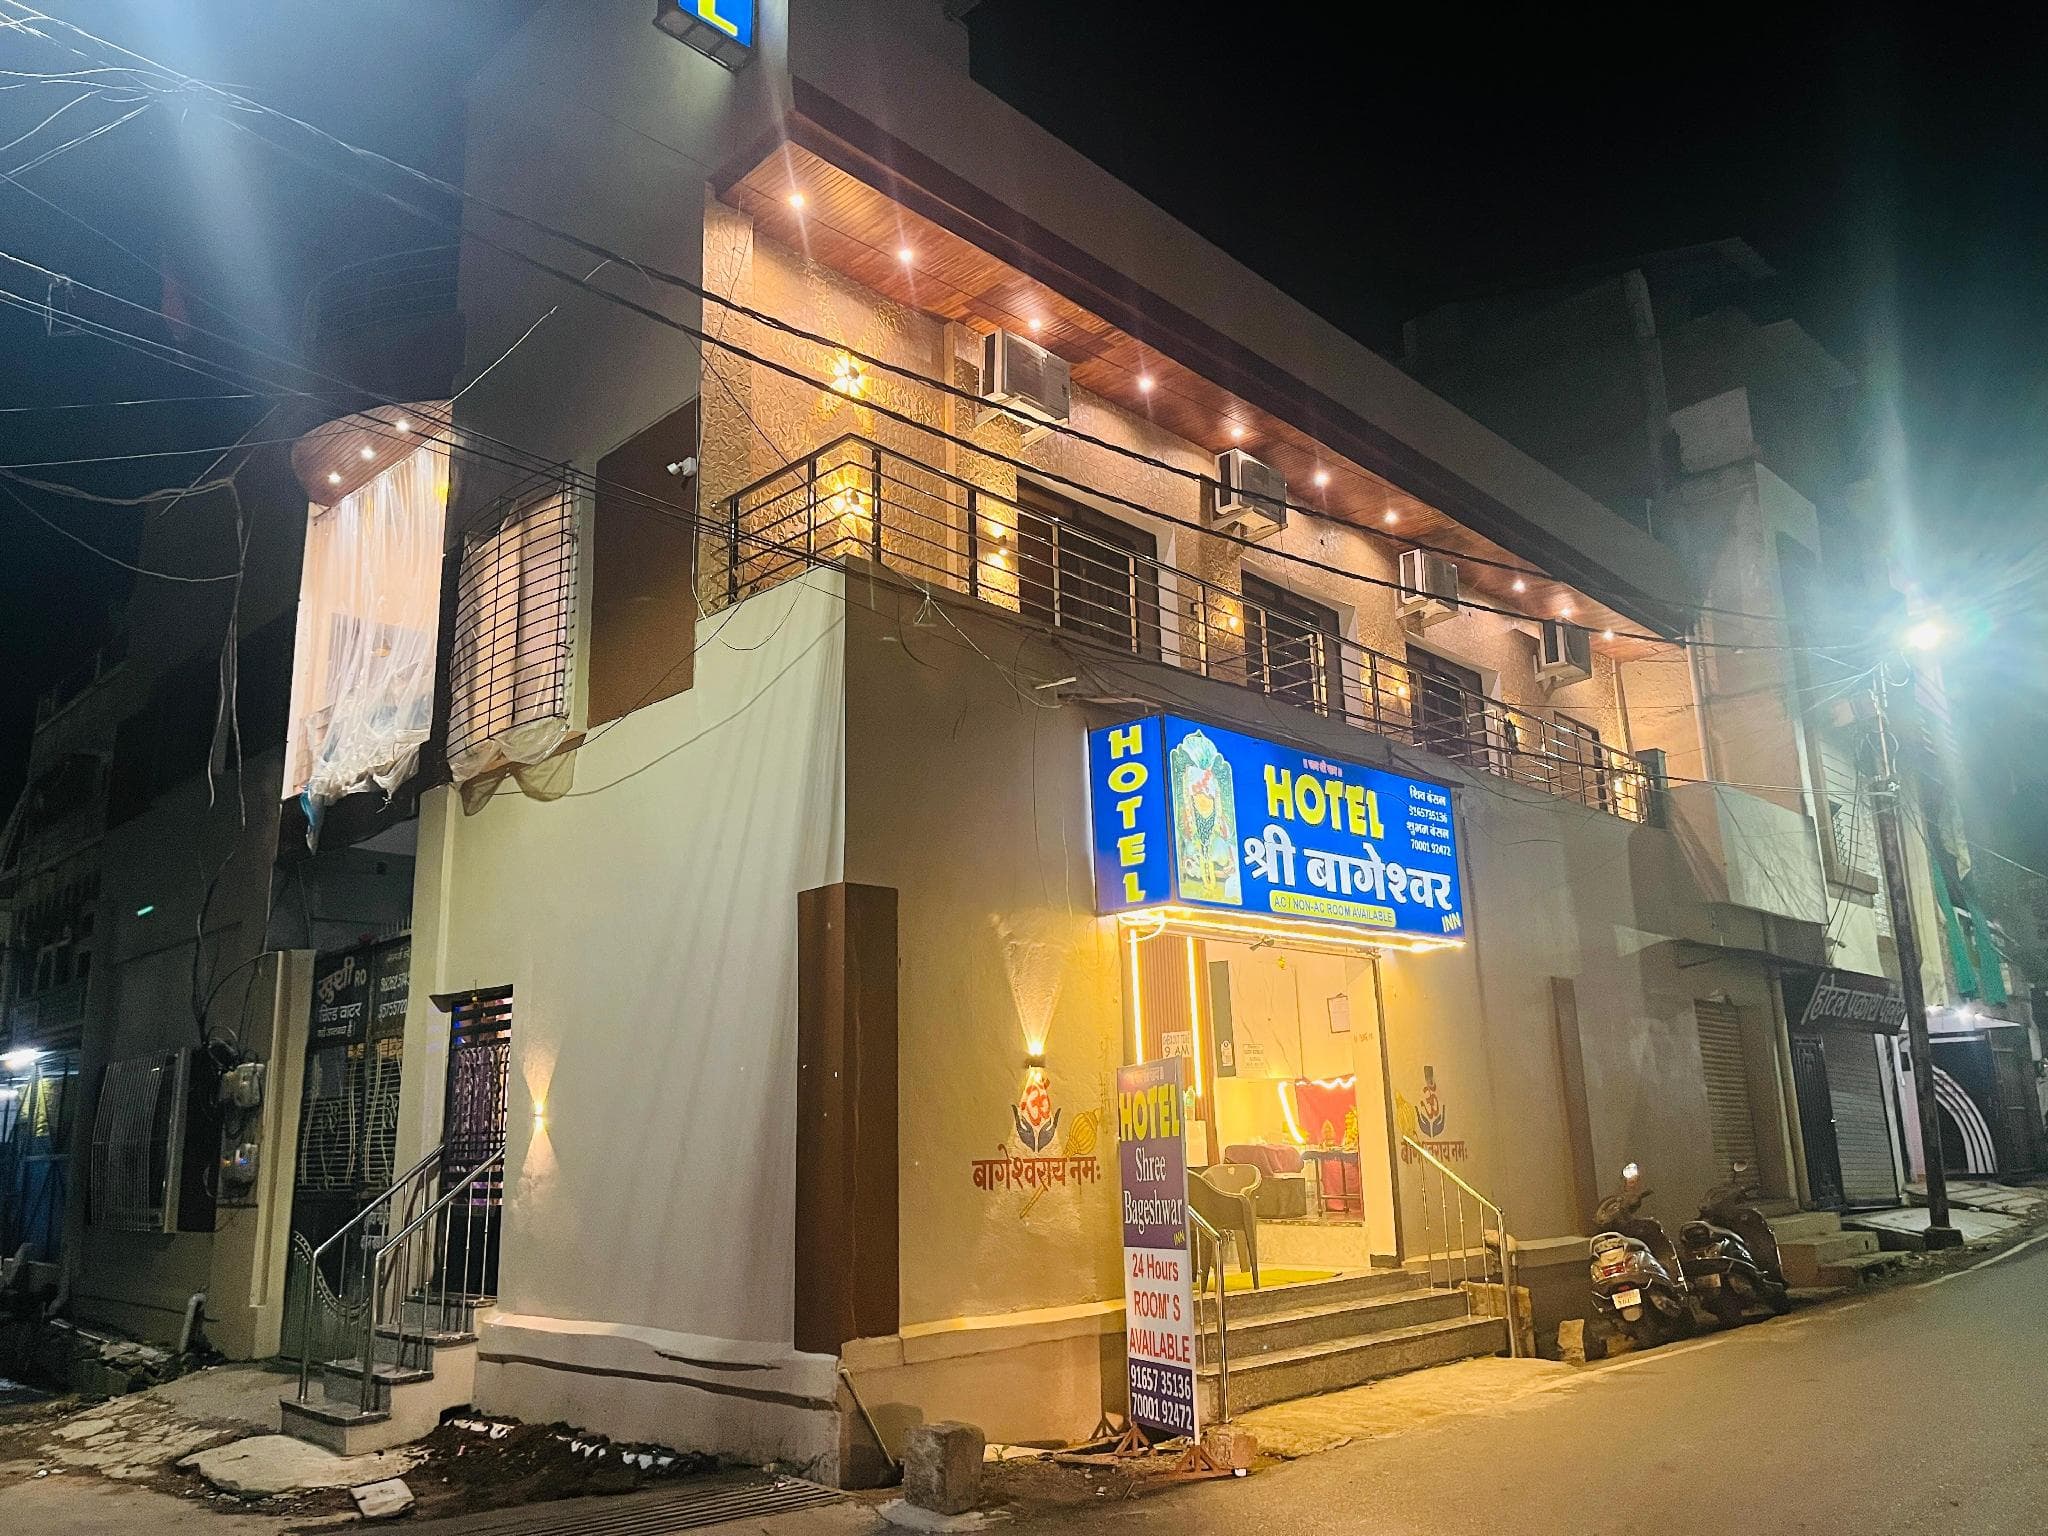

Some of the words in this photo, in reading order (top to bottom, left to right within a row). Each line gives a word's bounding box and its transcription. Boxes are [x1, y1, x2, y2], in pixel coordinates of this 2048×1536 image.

[1108, 724, 1148, 903] HOTEL
[1264, 763, 1385, 840] HOTEL
[1410, 838, 1430, 853] 70001
[1431, 842, 1451, 857] 92472
[1244, 823, 1296, 887] श्री
[1303, 842, 1453, 911] बागेश्वर
[1326, 903, 1351, 917] ROOM
[1352, 906, 1393, 923] AVAILABLE
[1441, 911, 1461, 934] INN
[354, 968, 367, 987] RO
[340, 1002, 362, 1019] वाटर
[1119, 1083, 1180, 1142] HOTEL
[1135, 1146, 1167, 1183] Shree
[1123, 1189, 1184, 1235] Bageshwar
[1132, 1253, 1145, 1278] 24
[1146, 1253, 1179, 1282] Hours
[1129, 1327, 1191, 1364] AVAILABLE
[1130, 1364, 1159, 1393] 91657
[1160, 1370, 1192, 1400] 35136
[1131, 1392, 1161, 1422] 70001
[1161, 1399, 1193, 1431] 92472
